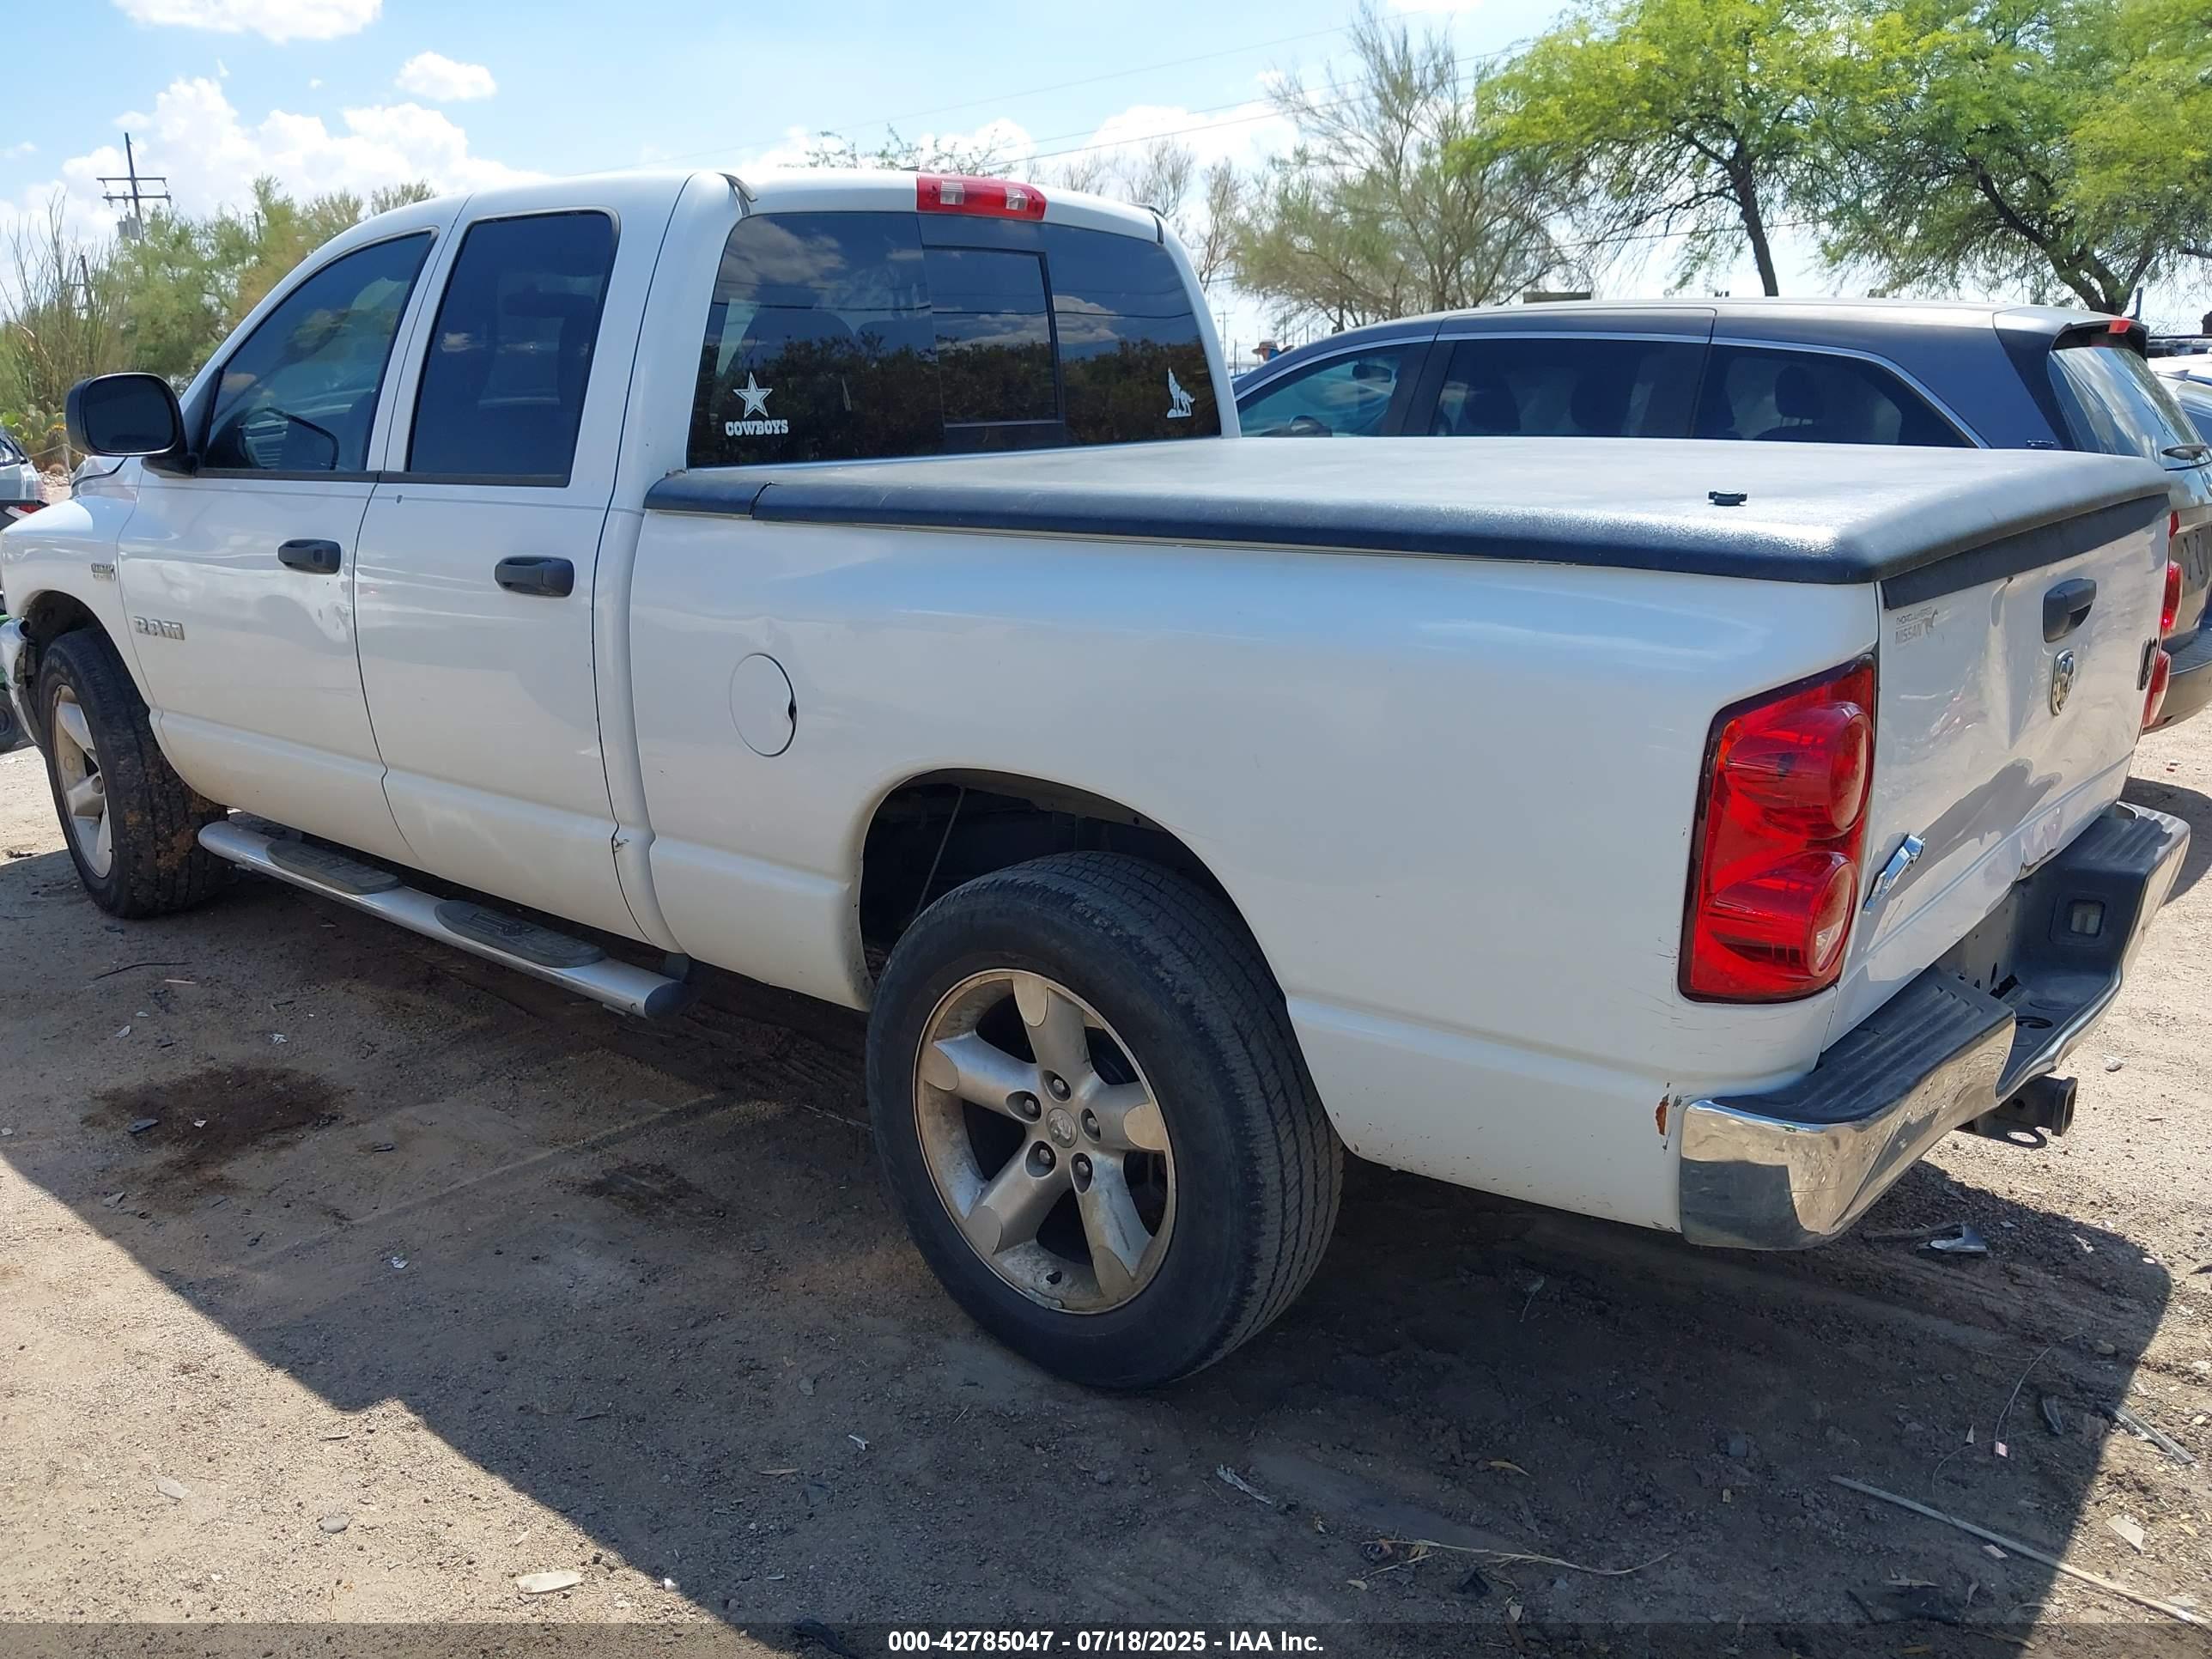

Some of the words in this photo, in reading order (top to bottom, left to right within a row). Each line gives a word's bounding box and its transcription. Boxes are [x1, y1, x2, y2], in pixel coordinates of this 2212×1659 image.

[725, 419, 789, 436] COWBOYS
[133, 616, 185, 641] RAM
[1895, 623, 1923, 645] NISSAN
